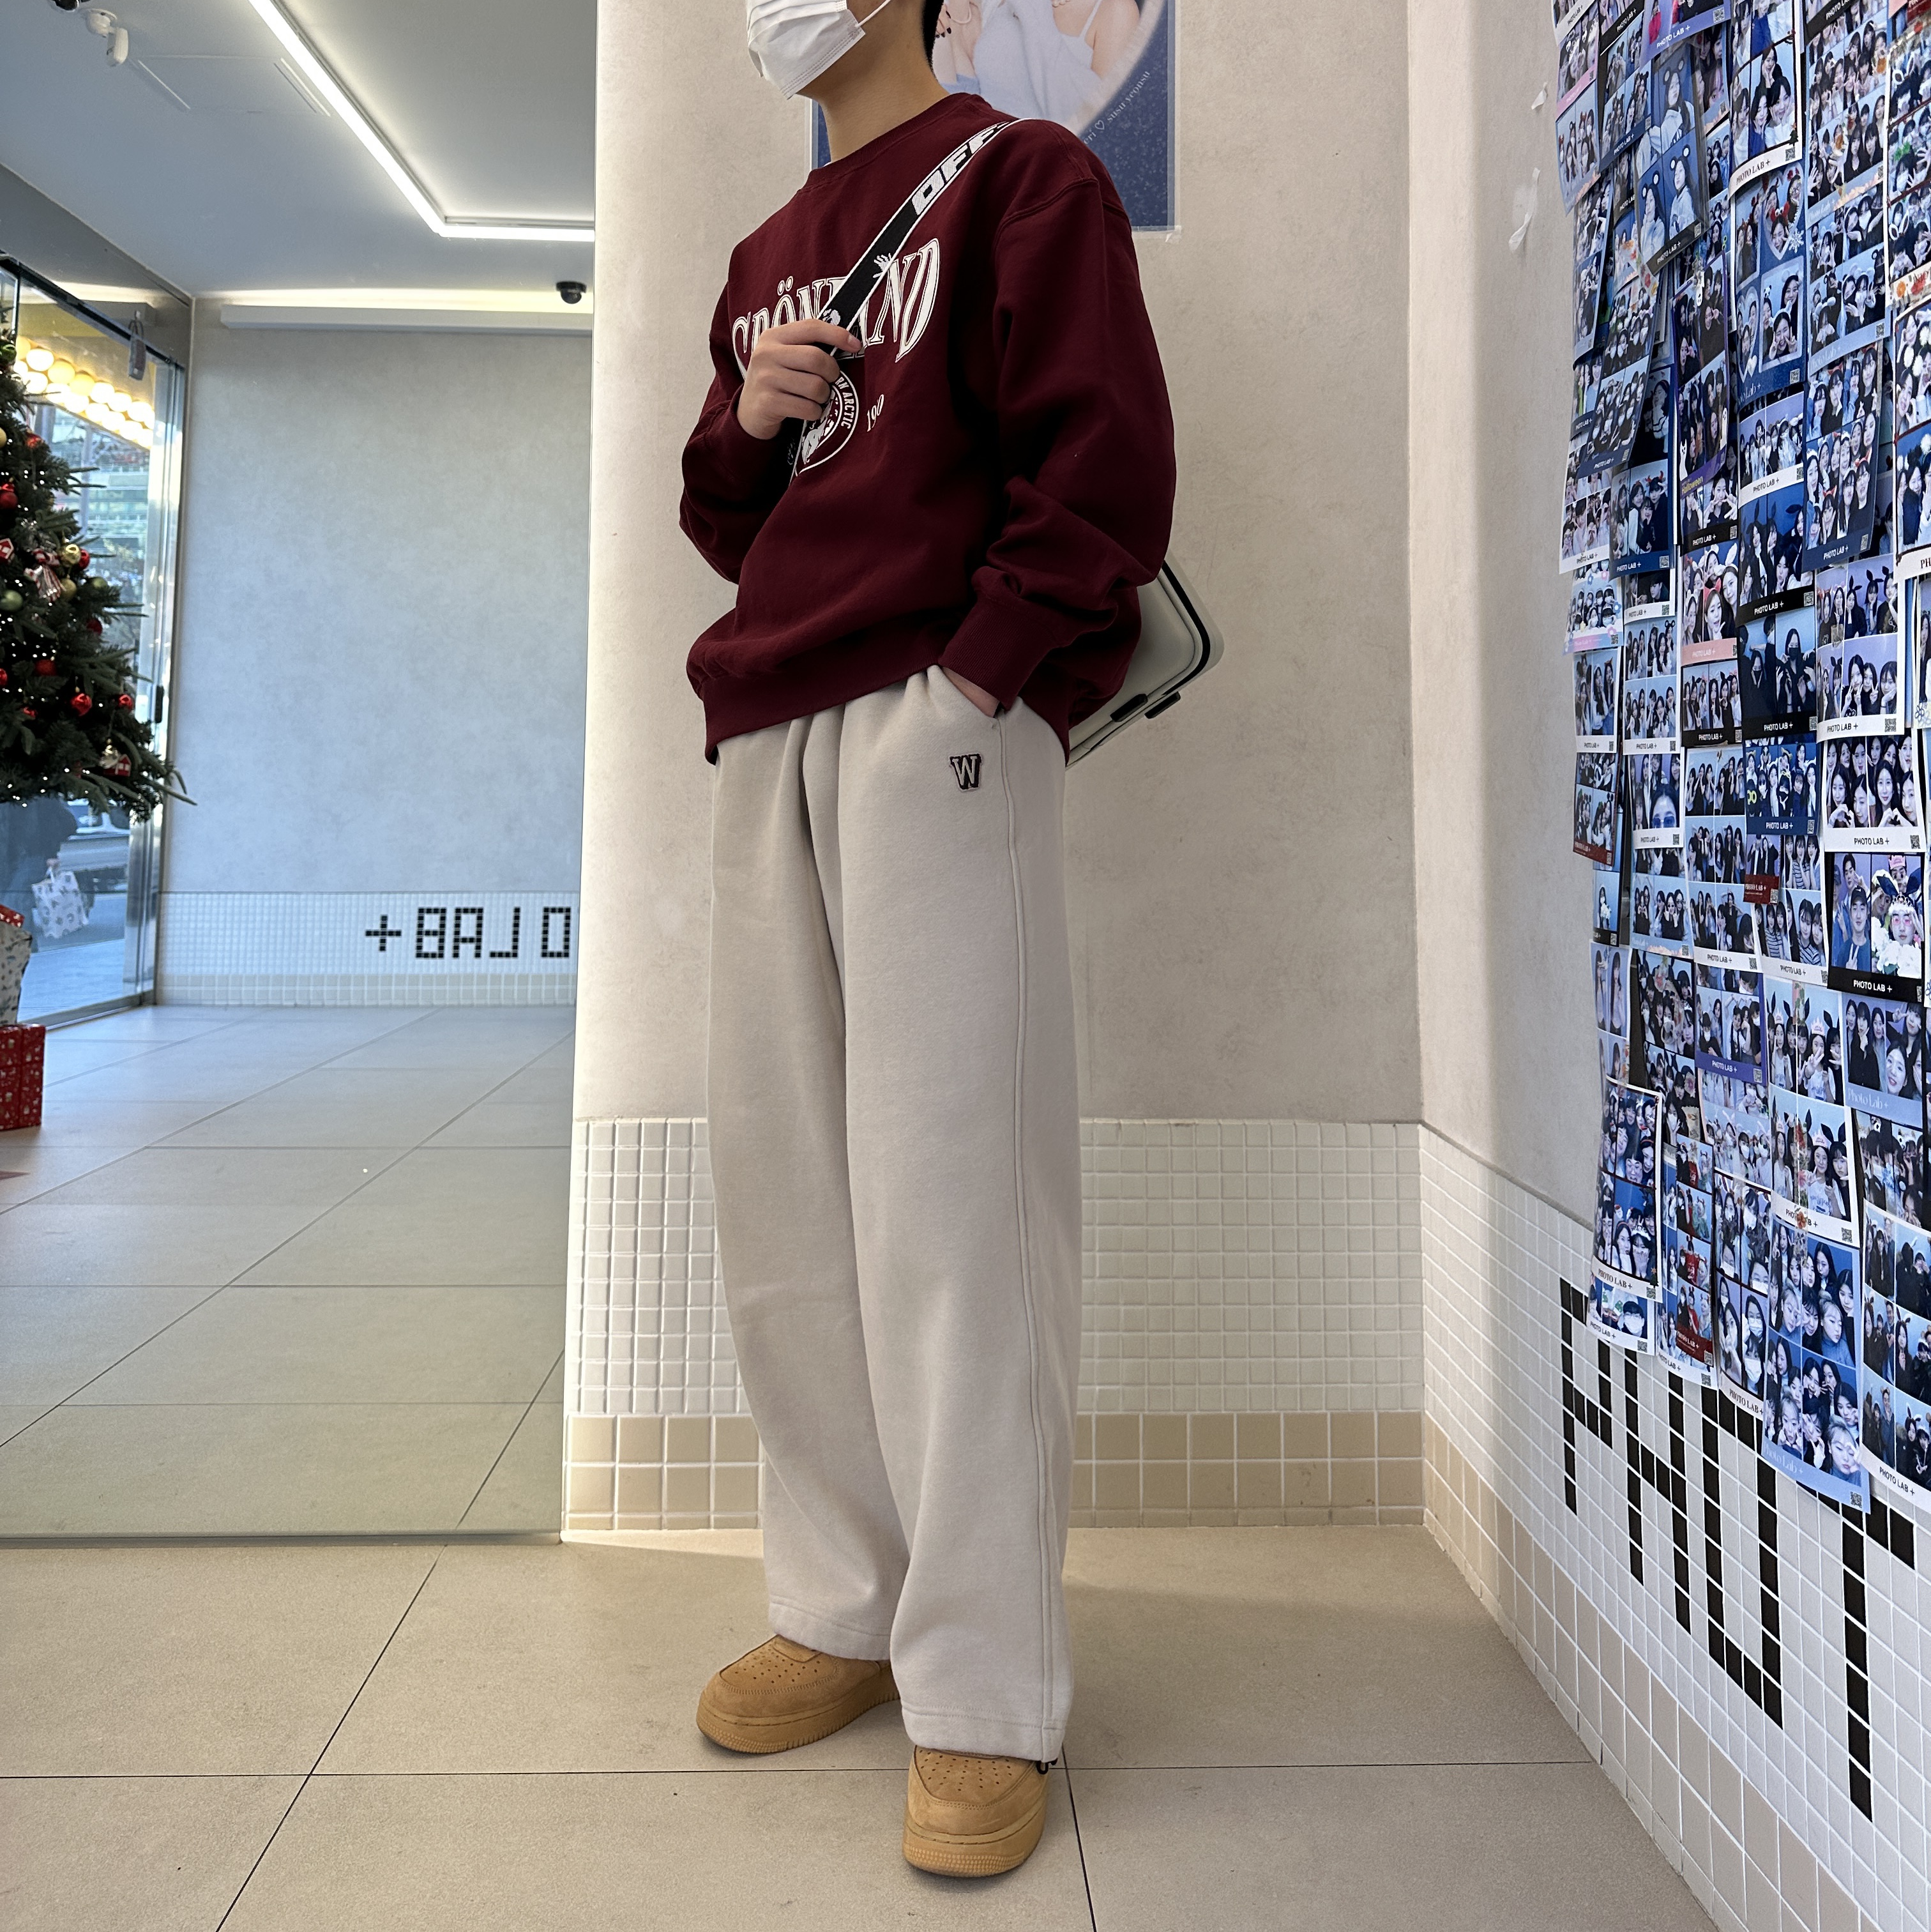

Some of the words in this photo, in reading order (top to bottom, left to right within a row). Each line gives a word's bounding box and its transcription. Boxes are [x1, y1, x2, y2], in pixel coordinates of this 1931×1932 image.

[1826, 1, 1841, 20] PHOTO
[1656, 35, 1672, 49] PHOTO
[1673, 29, 1685, 39] LAB
[1107, 102, 1126, 123] susu
[1125, 71, 1150, 105] yeonsu
[1737, 168, 1752, 185] PHOTO
[1752, 161, 1764, 174] LAB
[840, 392, 855, 430] ARCTIC
[1753, 483, 1766, 493] PHOTO
[1766, 478, 1775, 487] LAB
[1824, 549, 1836, 560] PHOTO
[1836, 546, 1845, 556] LAB
[1754, 605, 1768, 616] PHOTO
[1769, 602, 1778, 611] LAB
[1764, 724, 1778, 732] PHOTO
[1779, 722, 1789, 730] LAB
[1827, 724, 1840, 733] PHOTO
[1841, 722, 1852, 731] LAB
[949, 753, 982, 790] W
[1854, 837, 1872, 846] PHOTO
[1794, 968, 1802, 976] LAB
[1853, 980, 1872, 991] PHOTO
[1873, 982, 1886, 993] LAB
[1724, 1063, 1733, 1072] LAB
[1870, 1093, 1883, 1109] Lab
[1598, 1268, 1614, 1283] PHOTO
[1614, 1277, 1628, 1289] LAB
[1602, 1328, 1611, 1337] LAB
[1729, 1388, 1746, 1407] PHOTO
[1747, 1399, 1759, 1414] LAB
[1879, 1466, 1897, 1485] PHOTO
[1897, 1478, 1909, 1493] LAB
